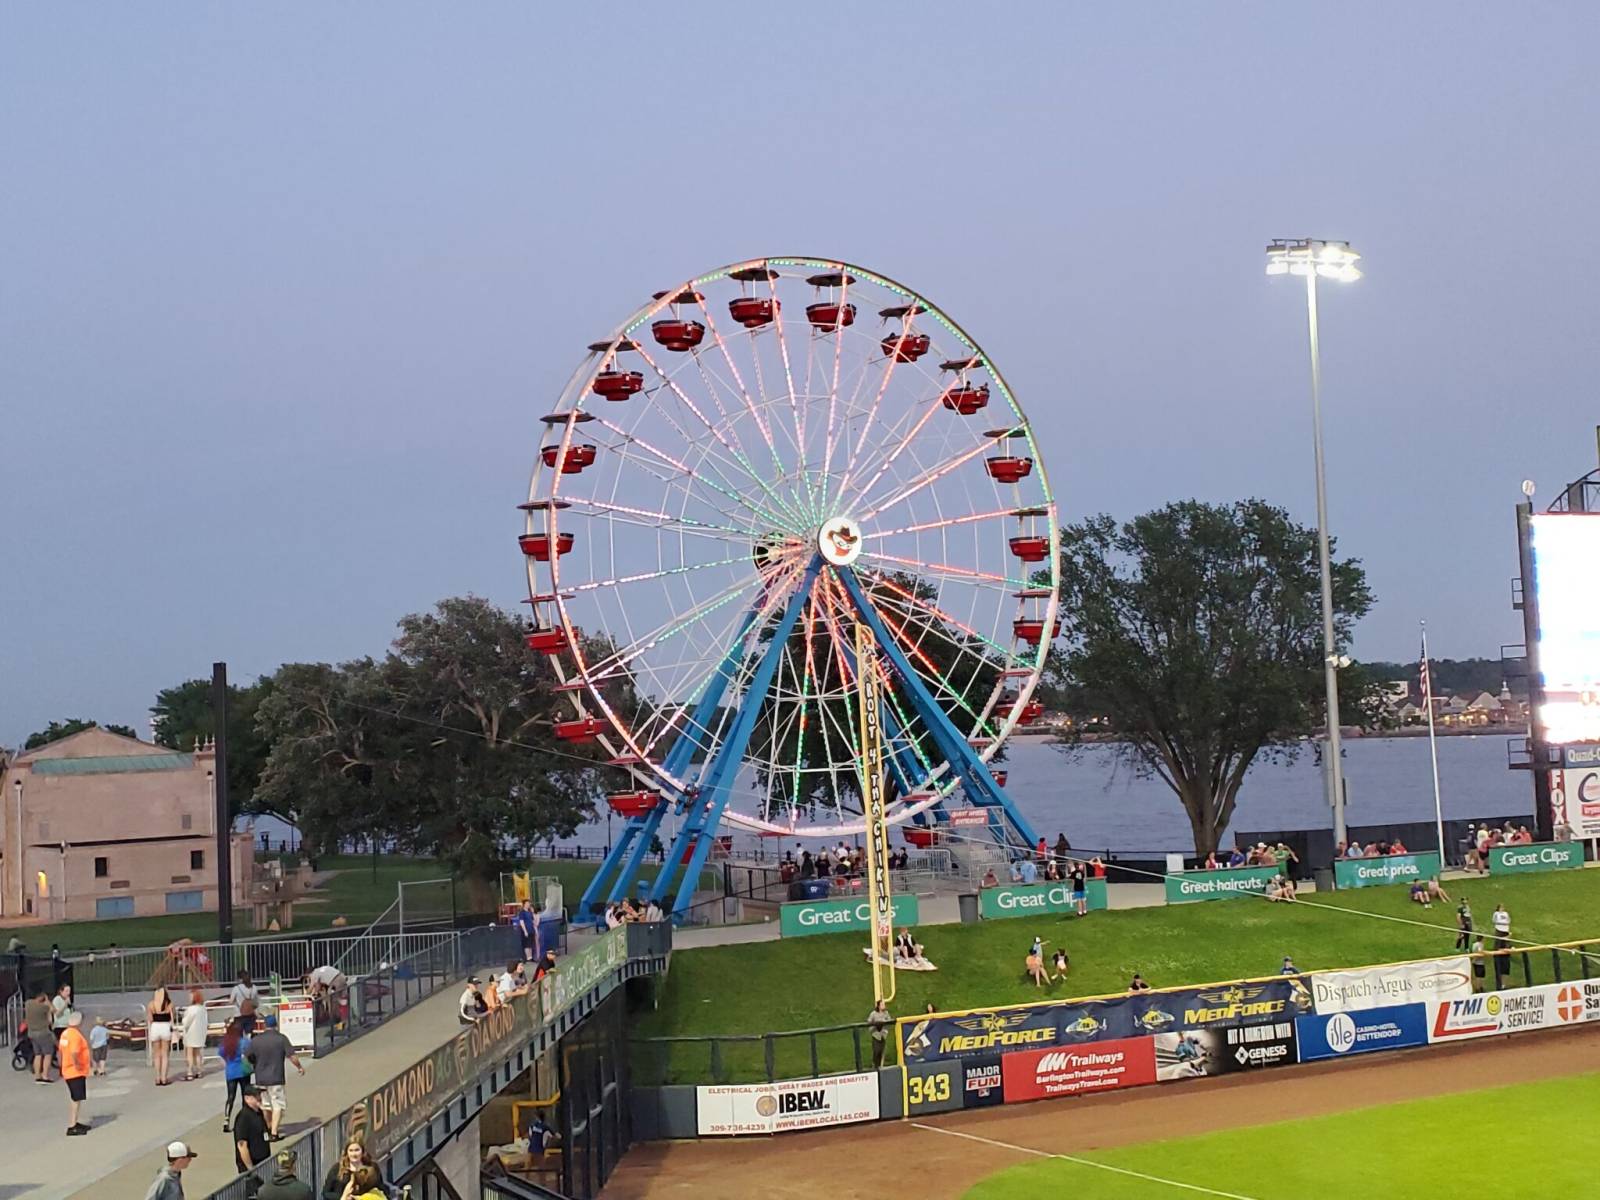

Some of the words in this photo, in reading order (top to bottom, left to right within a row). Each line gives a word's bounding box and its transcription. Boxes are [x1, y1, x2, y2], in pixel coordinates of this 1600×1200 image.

[865, 682, 877, 740] ROOT
[869, 748, 877, 765] 4
[1551, 769, 1565, 826] FOX
[1502, 851, 1538, 866] Great
[1540, 848, 1569, 866] Clips
[1358, 866, 1389, 878] Great
[1390, 864, 1420, 879] price.
[1180, 880, 1216, 894] Great
[1216, 877, 1266, 893] haircuts.
[997, 892, 1046, 909] Great
[798, 908, 851, 926] Great
[1316, 980, 1371, 1004] Dispatch
[1377, 976, 1413, 997] Argus
[1452, 997, 1484, 1017] TMI
[1504, 998, 1528, 1012] HOME
[1529, 994, 1545, 1008] RUN
[1507, 1010, 1544, 1028] SERVICE!
[1071, 1052, 1124, 1067] Trailways
[1248, 1044, 1288, 1060] GENESIS
[966, 1065, 1000, 1079] MAJOR
[708, 1087, 752, 1095] ELECTRICAL
[909, 1073, 951, 1104] 343
[968, 1078, 999, 1089] FUN
[373, 1058, 434, 1132] DIAMOND
[778, 1089, 826, 1115] IBEW
